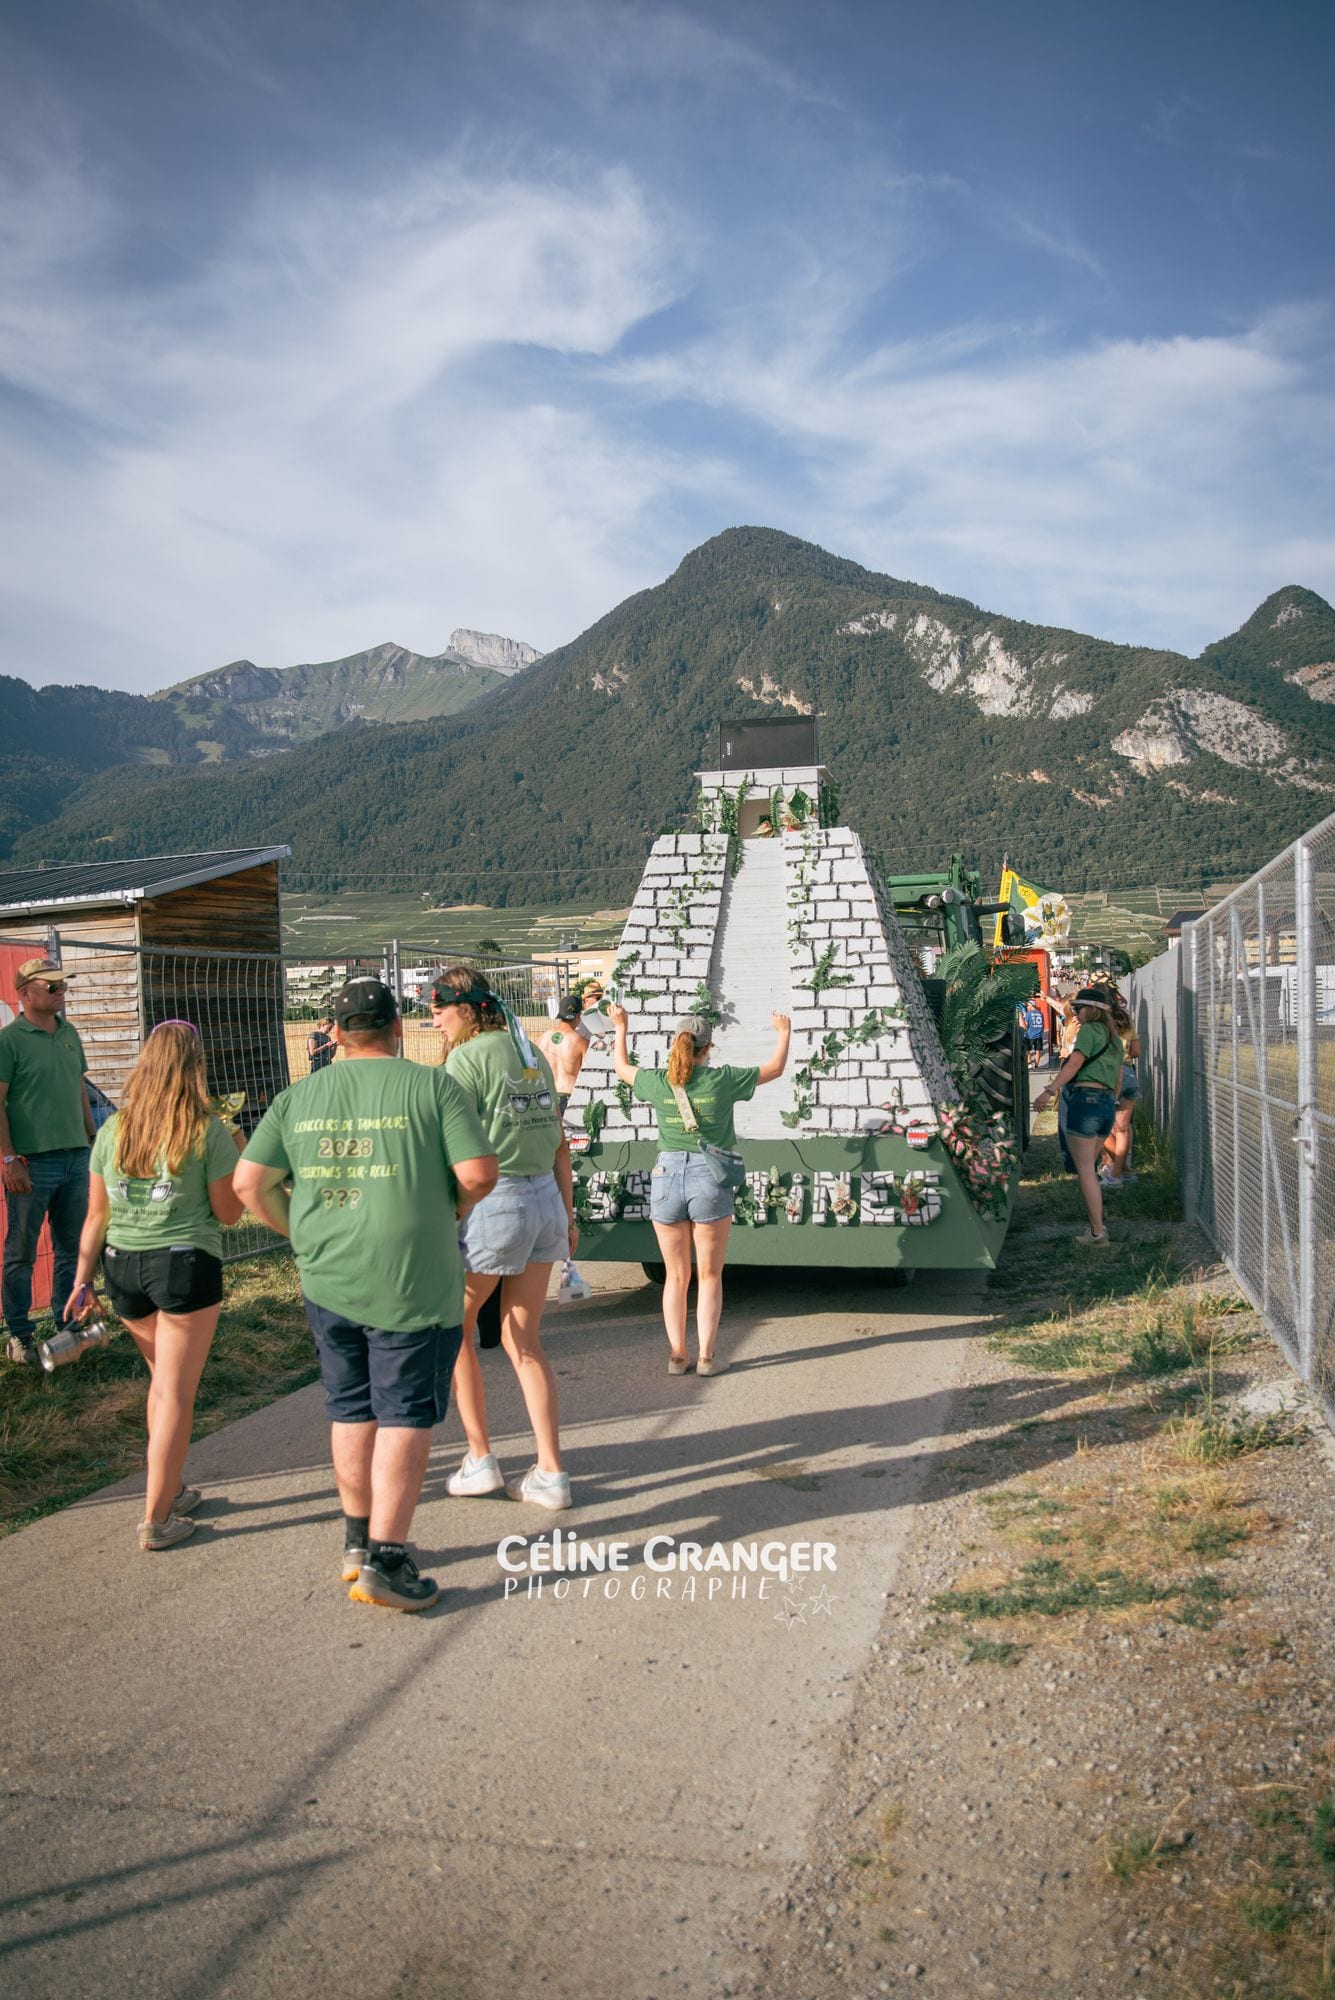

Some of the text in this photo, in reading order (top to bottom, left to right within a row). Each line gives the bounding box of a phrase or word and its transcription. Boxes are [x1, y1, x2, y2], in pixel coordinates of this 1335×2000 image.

[1031, 1016, 1043, 1025] 10
[342, 1120, 353, 1132] DE
[318, 1137, 374, 1158] 2028
